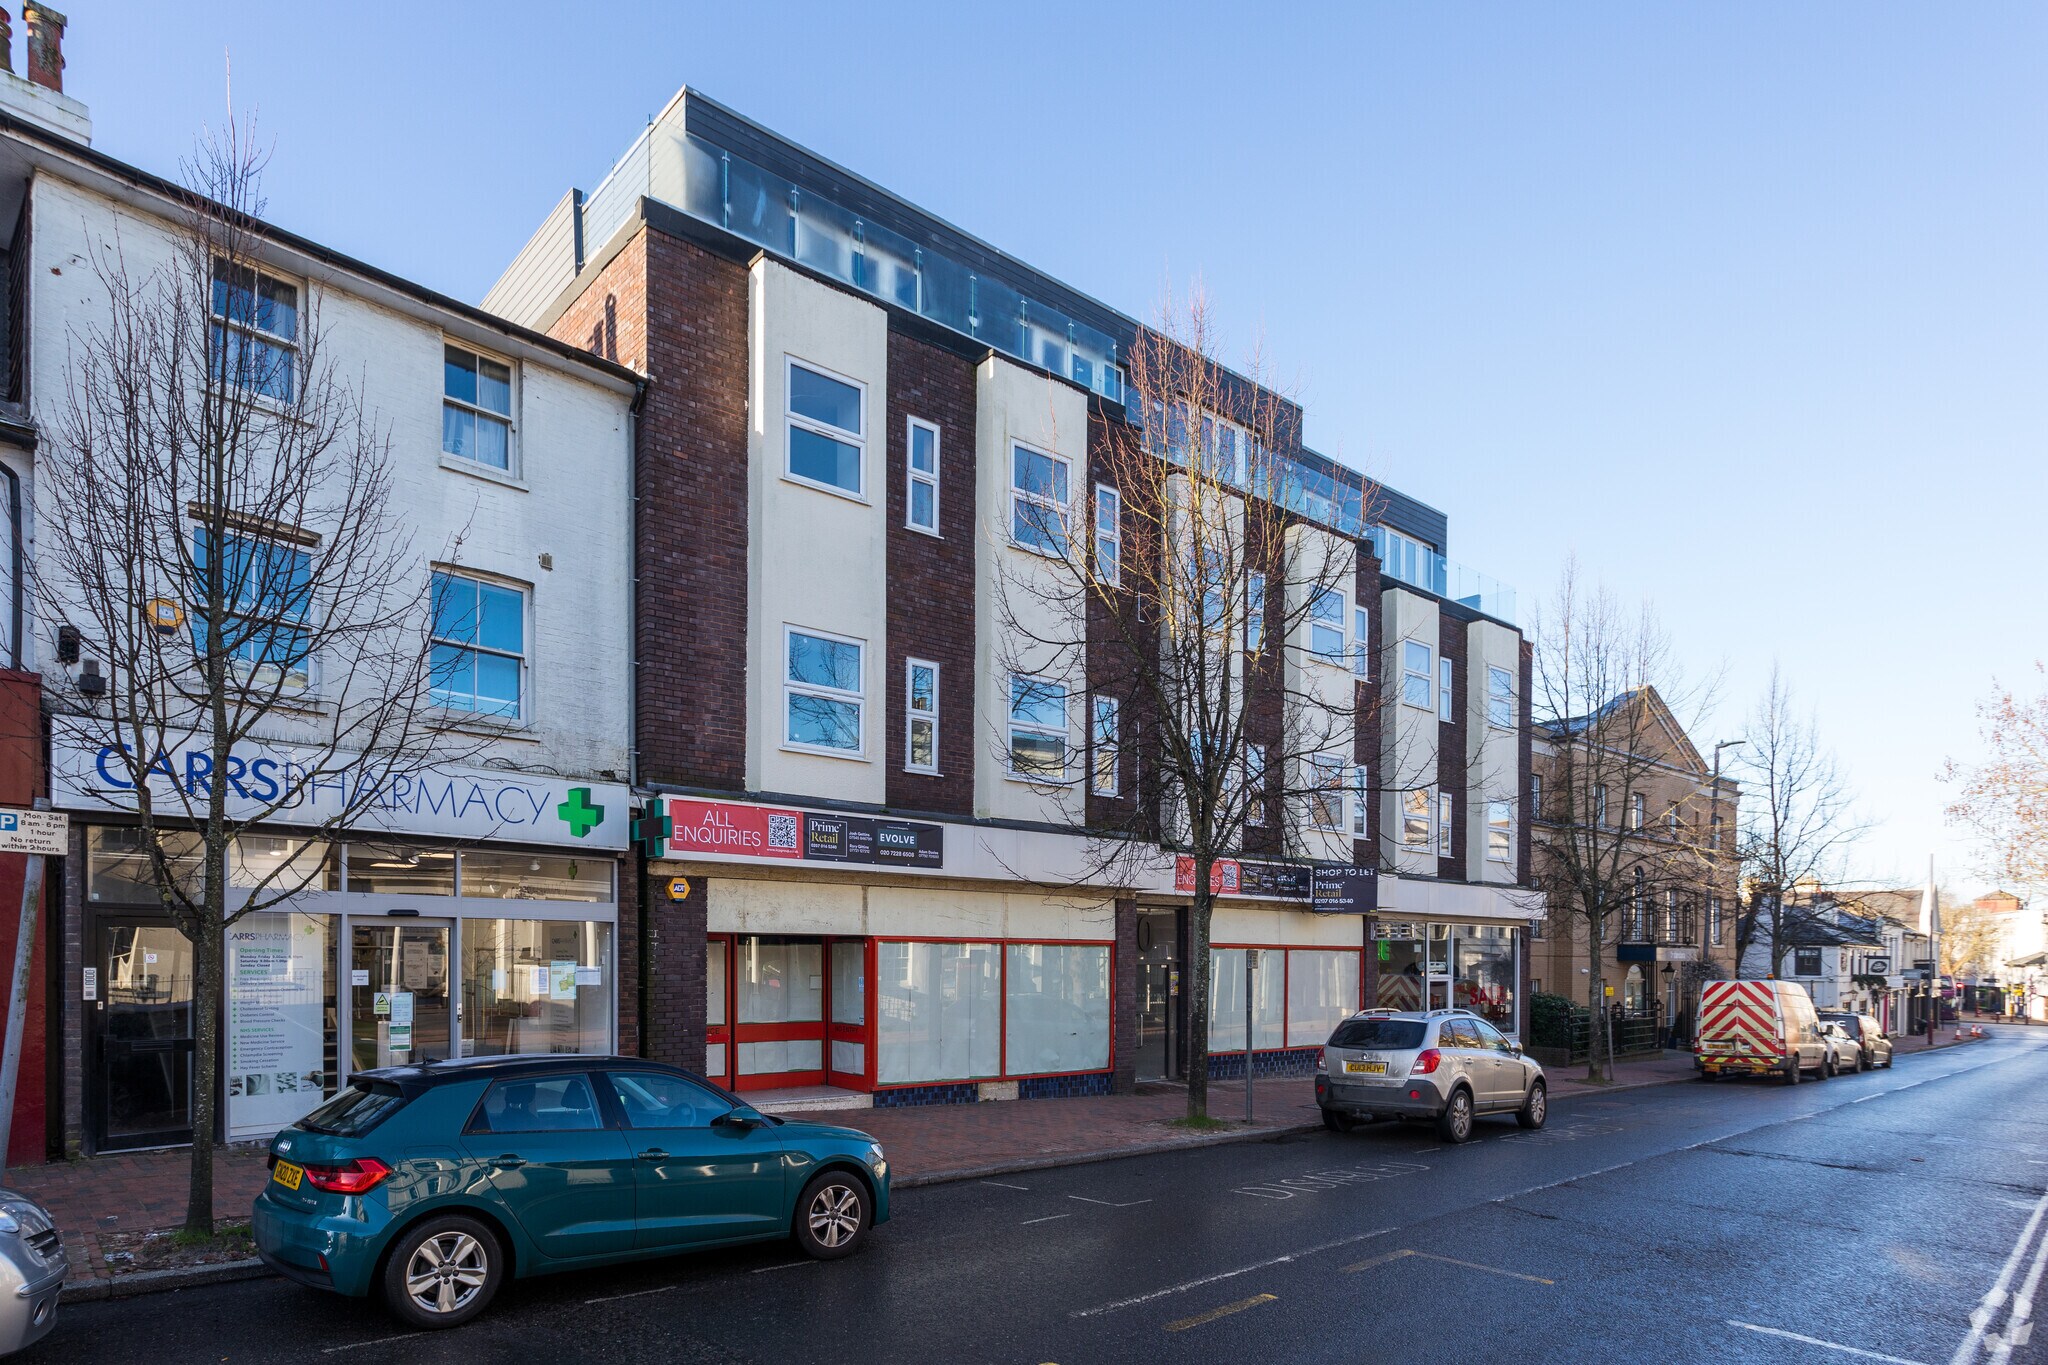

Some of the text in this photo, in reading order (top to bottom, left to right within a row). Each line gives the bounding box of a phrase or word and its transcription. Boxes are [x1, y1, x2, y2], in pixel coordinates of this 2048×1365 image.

[1, 815, 15, 829] P
[24, 812, 42, 820] Mon
[48, 814, 63, 822] Sat
[703, 810, 735, 828] ALL
[811, 820, 840, 833] Prime
[25, 837, 52, 845] return
[674, 825, 762, 848] ENQUIRIES
[811, 832, 839, 844] Retail
[880, 833, 915, 845] EVOLVE
[1315, 868, 1375, 877] SHOP TO LET
[1315, 881, 1343, 889] Prime
[1315, 889, 1342, 897] Retail
